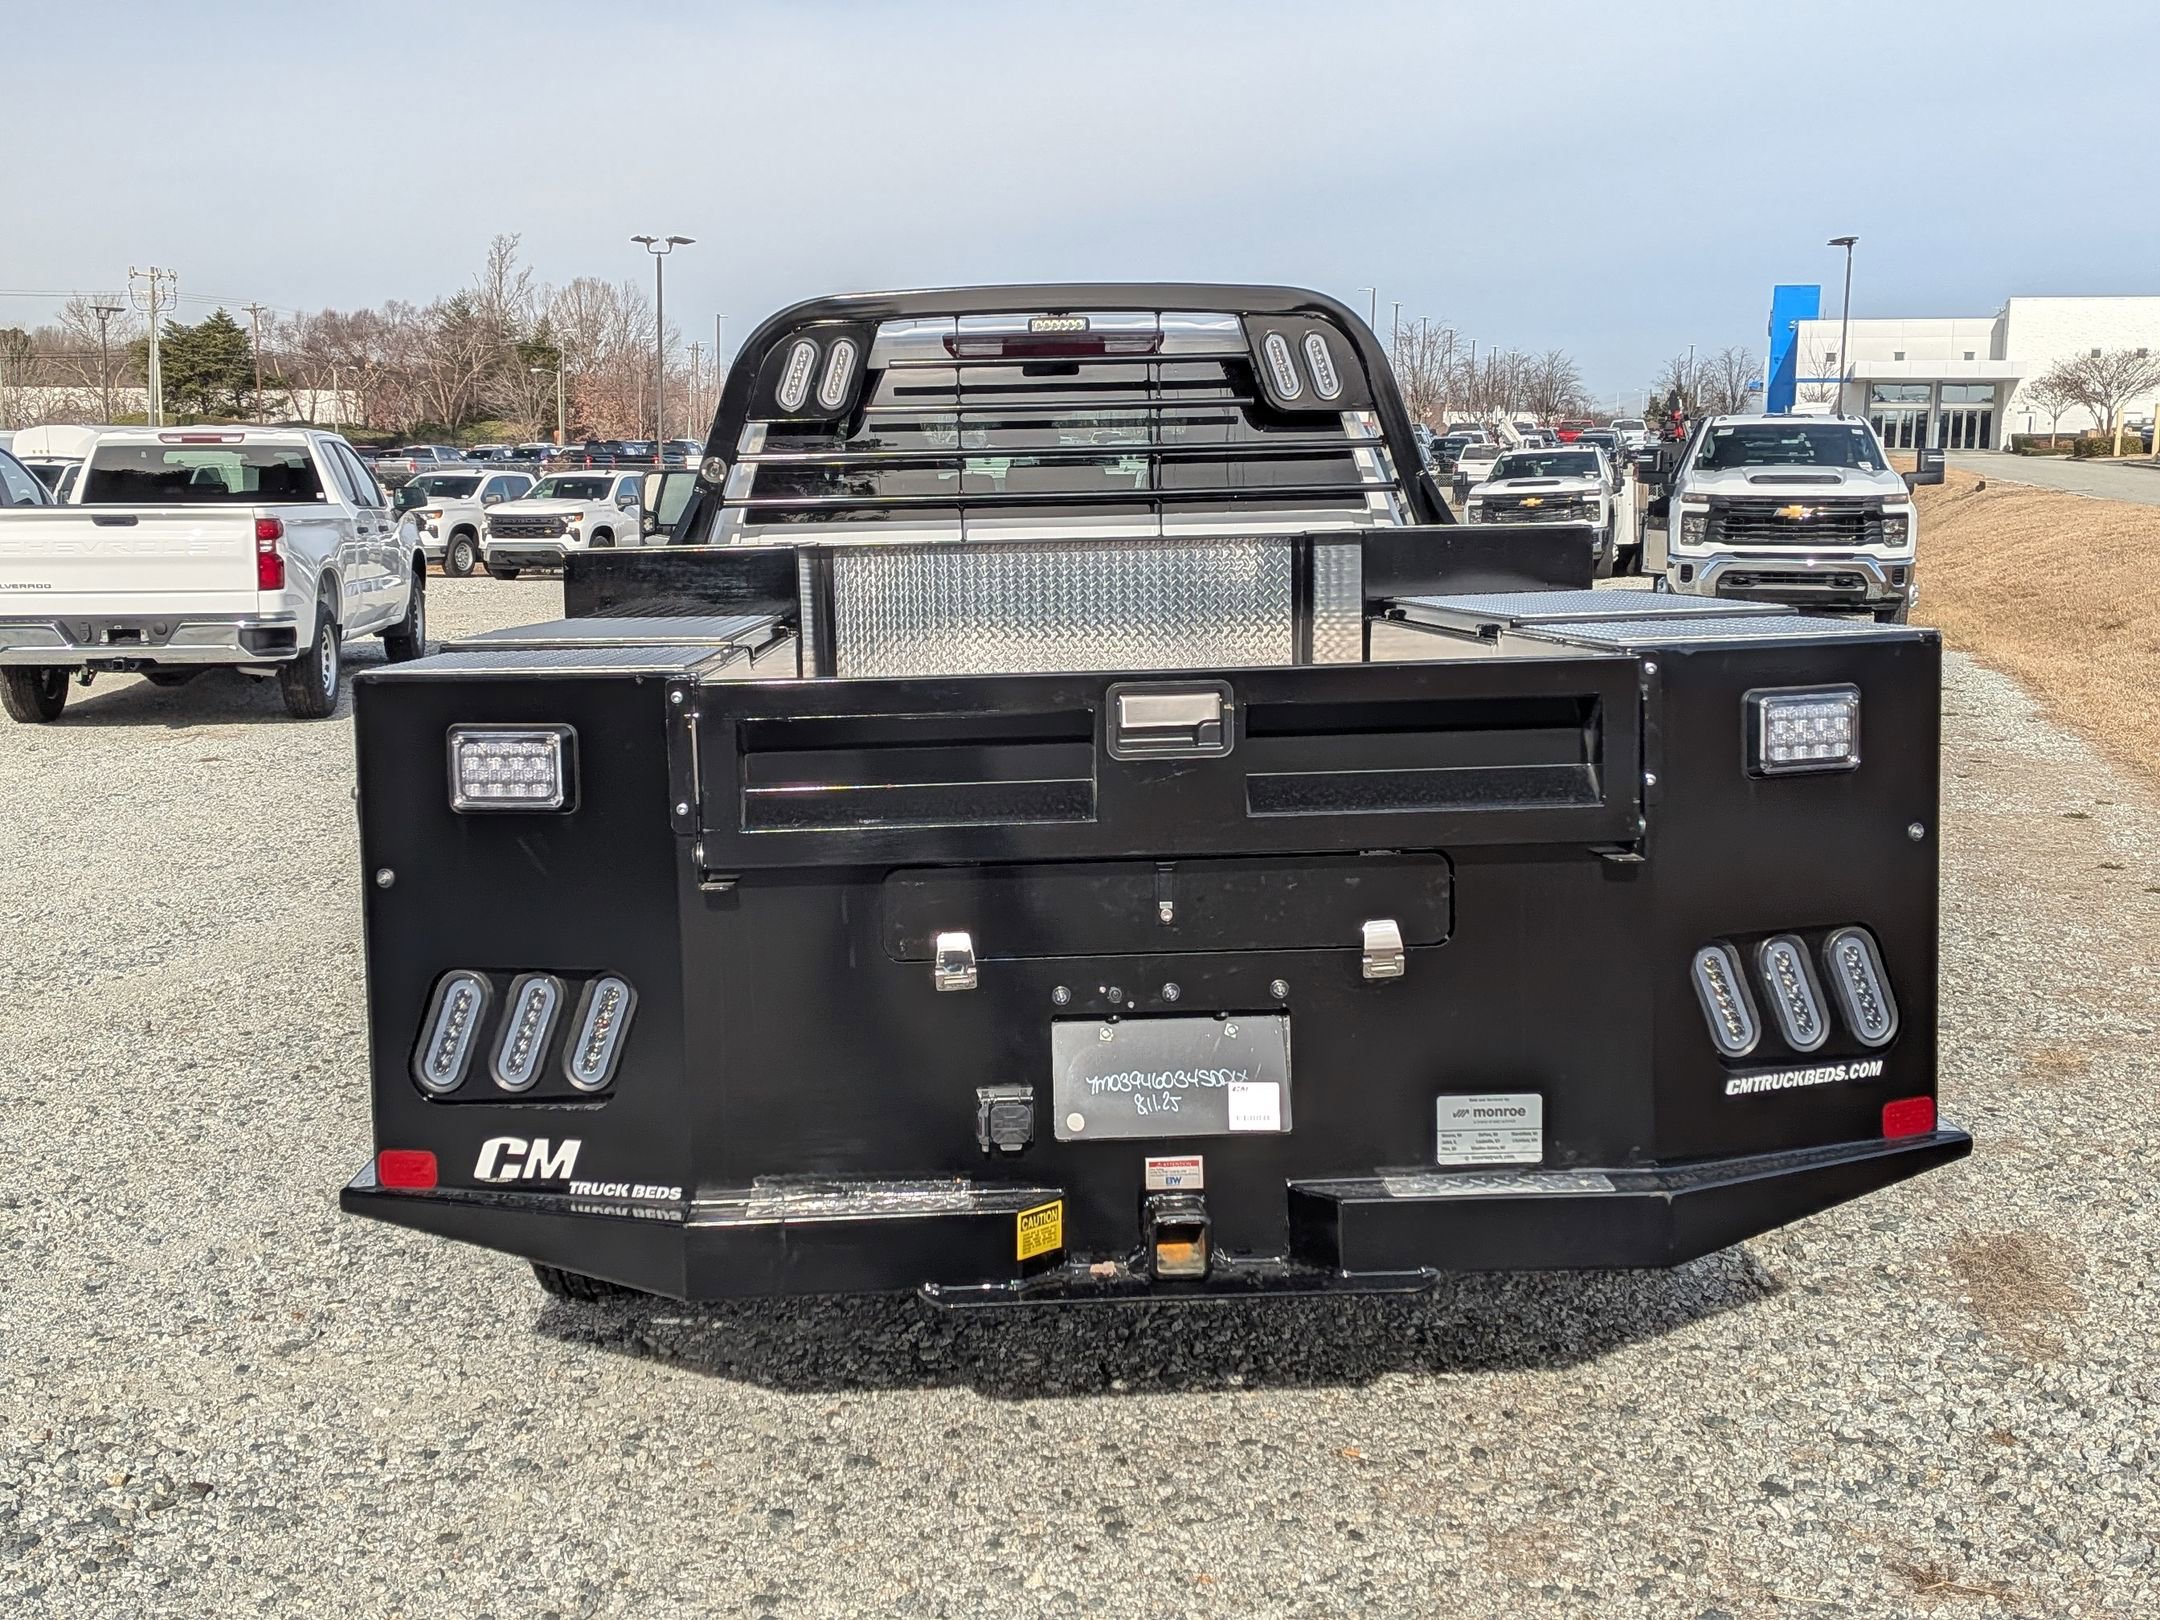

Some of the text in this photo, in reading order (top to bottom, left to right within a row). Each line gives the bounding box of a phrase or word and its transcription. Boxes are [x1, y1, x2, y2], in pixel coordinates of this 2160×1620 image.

[1725, 1060, 1883, 1095] CMTRUCKBEDS.COM
[1473, 1107, 1526, 1118] monroe
[473, 1136, 582, 1183] CM
[569, 1181, 682, 1200] TRUCK BEDS
[1022, 1208, 1058, 1231] CAUTION
